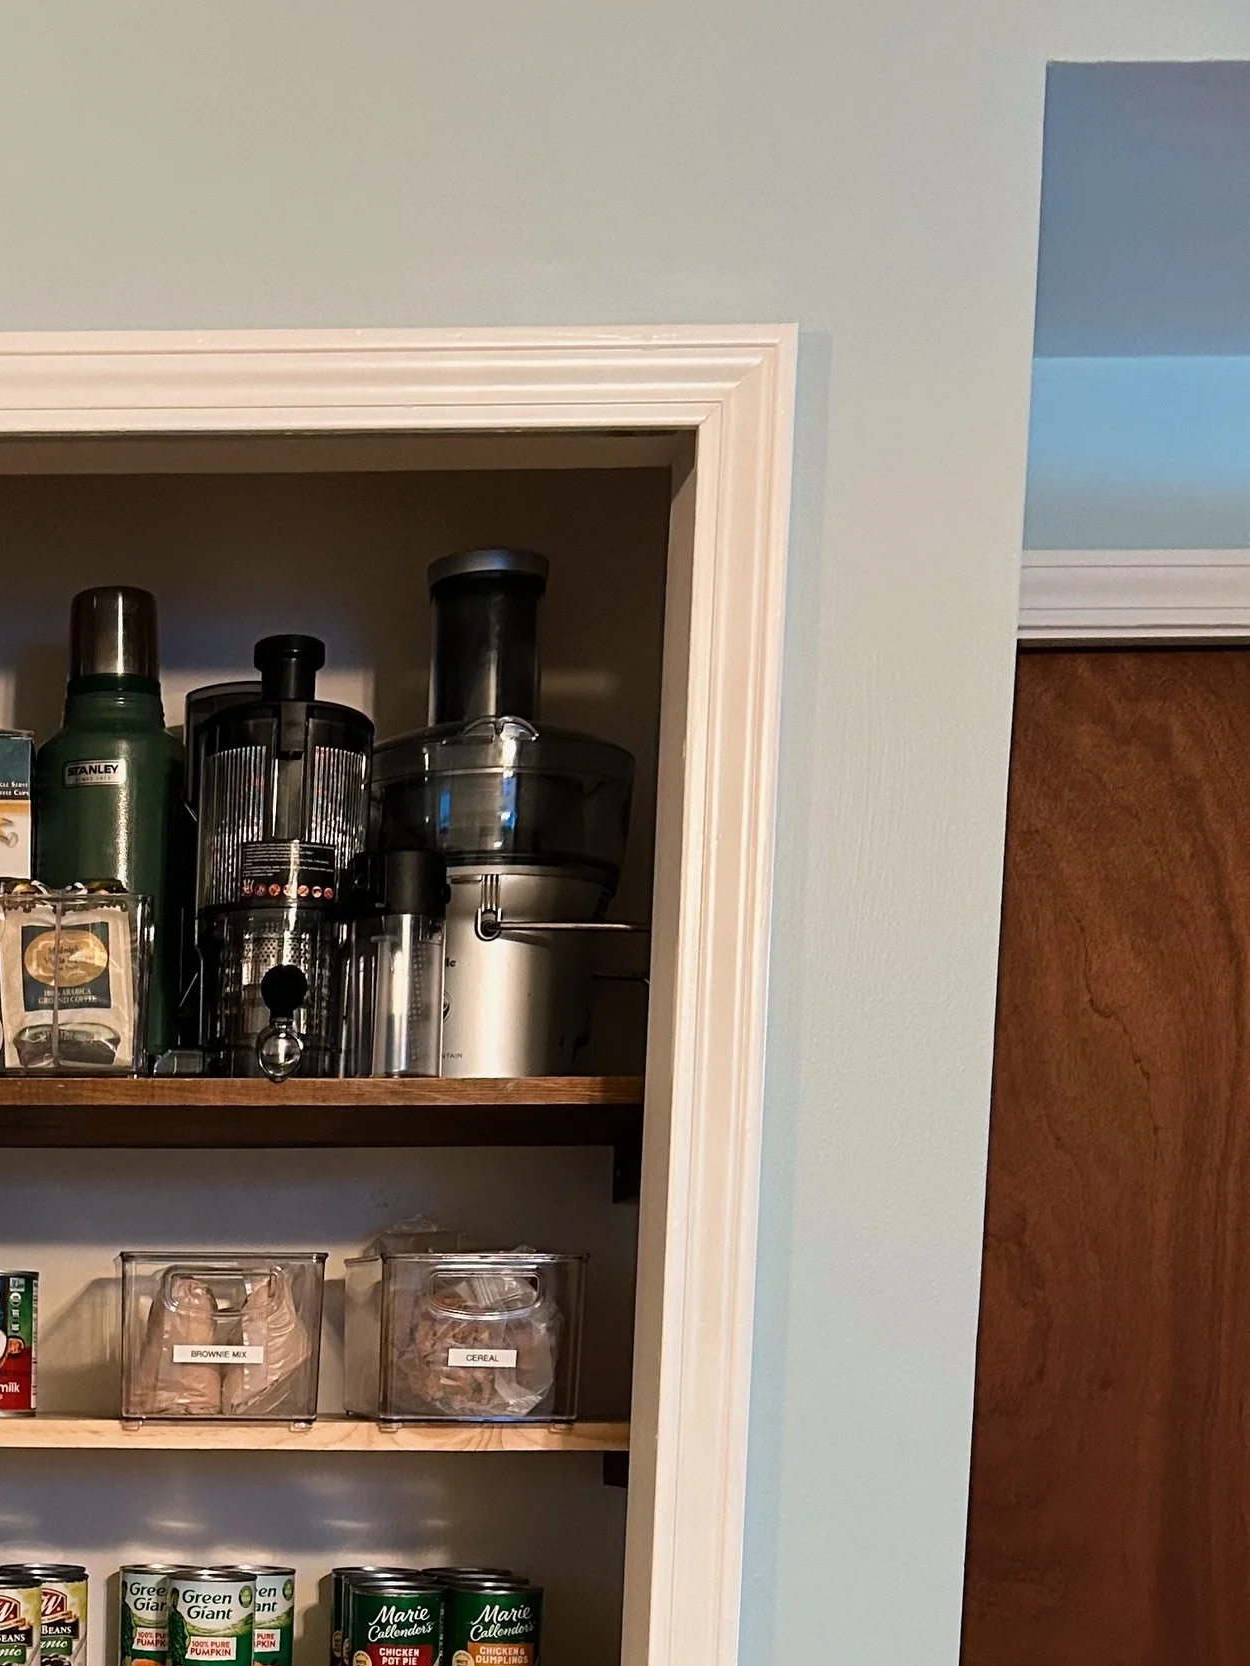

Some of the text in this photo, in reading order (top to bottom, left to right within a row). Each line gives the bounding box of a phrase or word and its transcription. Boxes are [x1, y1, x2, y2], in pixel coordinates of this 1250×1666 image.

[67, 764, 119, 776] STANLEY
[191, 1350, 229, 1358] BROWNIE
[466, 1354, 499, 1362] CEREAL
[129, 1582, 166, 1596] Gree
[182, 1589, 232, 1605] Green
[187, 1605, 233, 1620] Giant
[369, 1605, 430, 1626] Marie
[471, 1604, 532, 1625] Marie
[136, 1638, 166, 1647] PUMPK
[190, 1648, 231, 1656] PUMPKIN
[379, 1648, 419, 1656] CHICKEN
[479, 1647, 518, 1655] CHICKEN
[382, 1657, 417, 1665] POT PIE
[475, 1655, 528, 1664] DUMPLINGS
